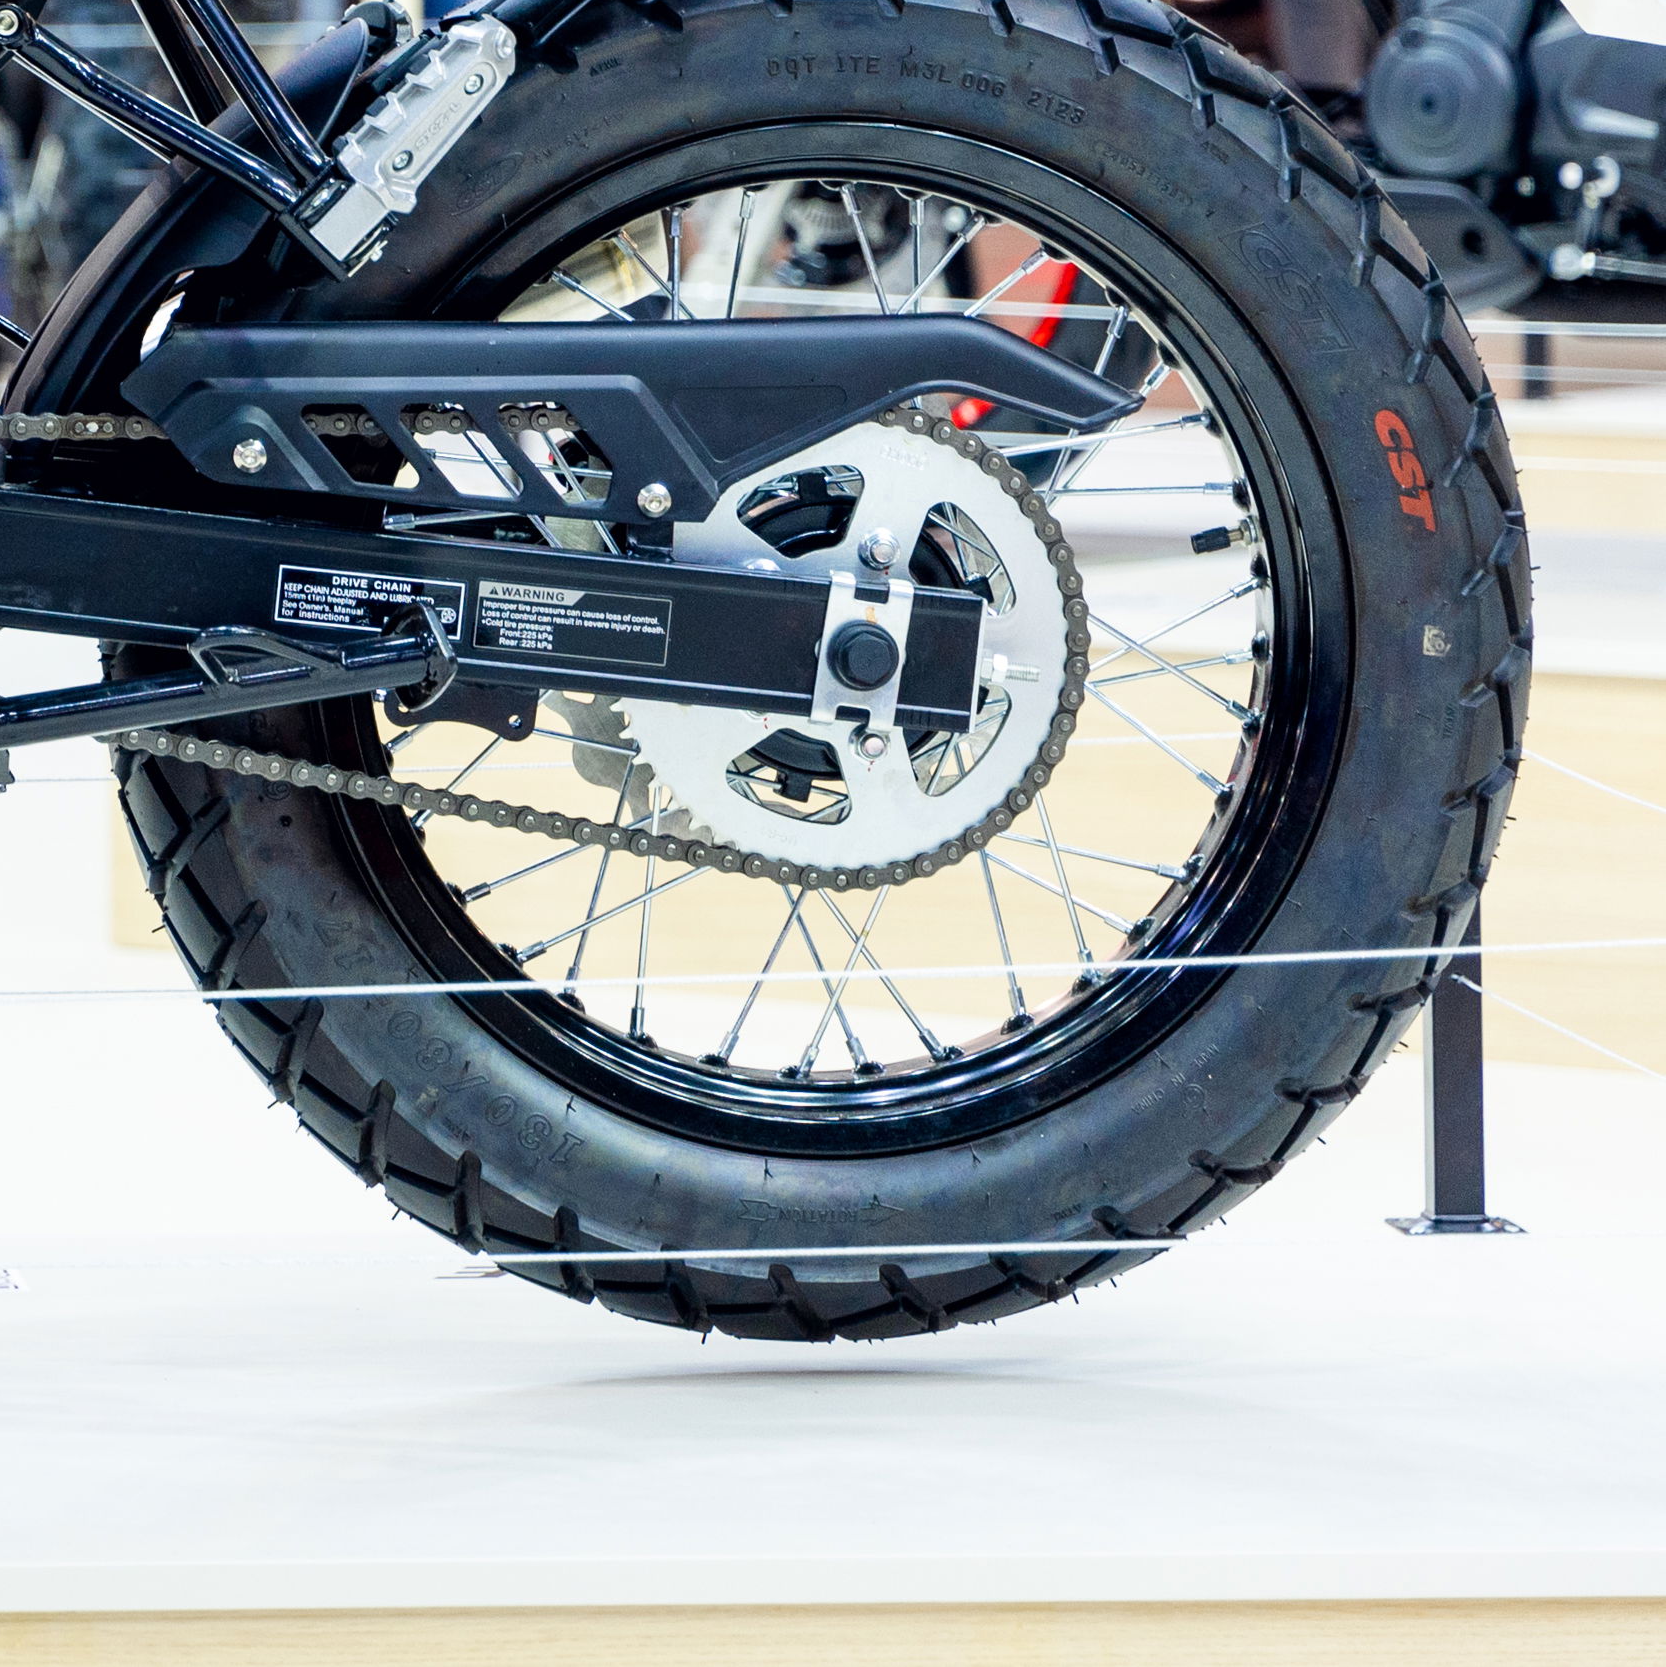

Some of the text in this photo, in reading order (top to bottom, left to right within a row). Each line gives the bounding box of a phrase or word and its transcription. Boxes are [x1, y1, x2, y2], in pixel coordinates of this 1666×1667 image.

[1373, 409, 1437, 533] CST
[284, 582, 303, 592] KEEP
[304, 584, 330, 595] CHAIN
[330, 588, 369, 600] ADJUSTED
[369, 592, 388, 602] AND
[332, 576, 411, 593] DRIVE CHAIN
[327, 594, 357, 607] freeplay
[502, 586, 565, 602] WARNING
[282, 600, 297, 609] See
[333, 605, 364, 615] Manual
[483, 600, 659, 625] Improper tire pressure can cause loss of control.
[281, 608, 350, 623] for instructions
[482, 610, 500, 618] Loss
[501, 611, 510, 619] of
[510, 613, 537, 622] control
[553, 617, 575, 626] result
[575, 618, 583, 626] in
[584, 621, 609, 630] severe
[611, 622, 631, 633] injury
[642, 625, 666, 635] death.
[504, 619, 517, 629] tire
[518, 622, 554, 633] pressure:
[499, 637, 517, 647] Rear
[537, 640, 553, 650] kPa
[538, 632, 553, 641] kPa
